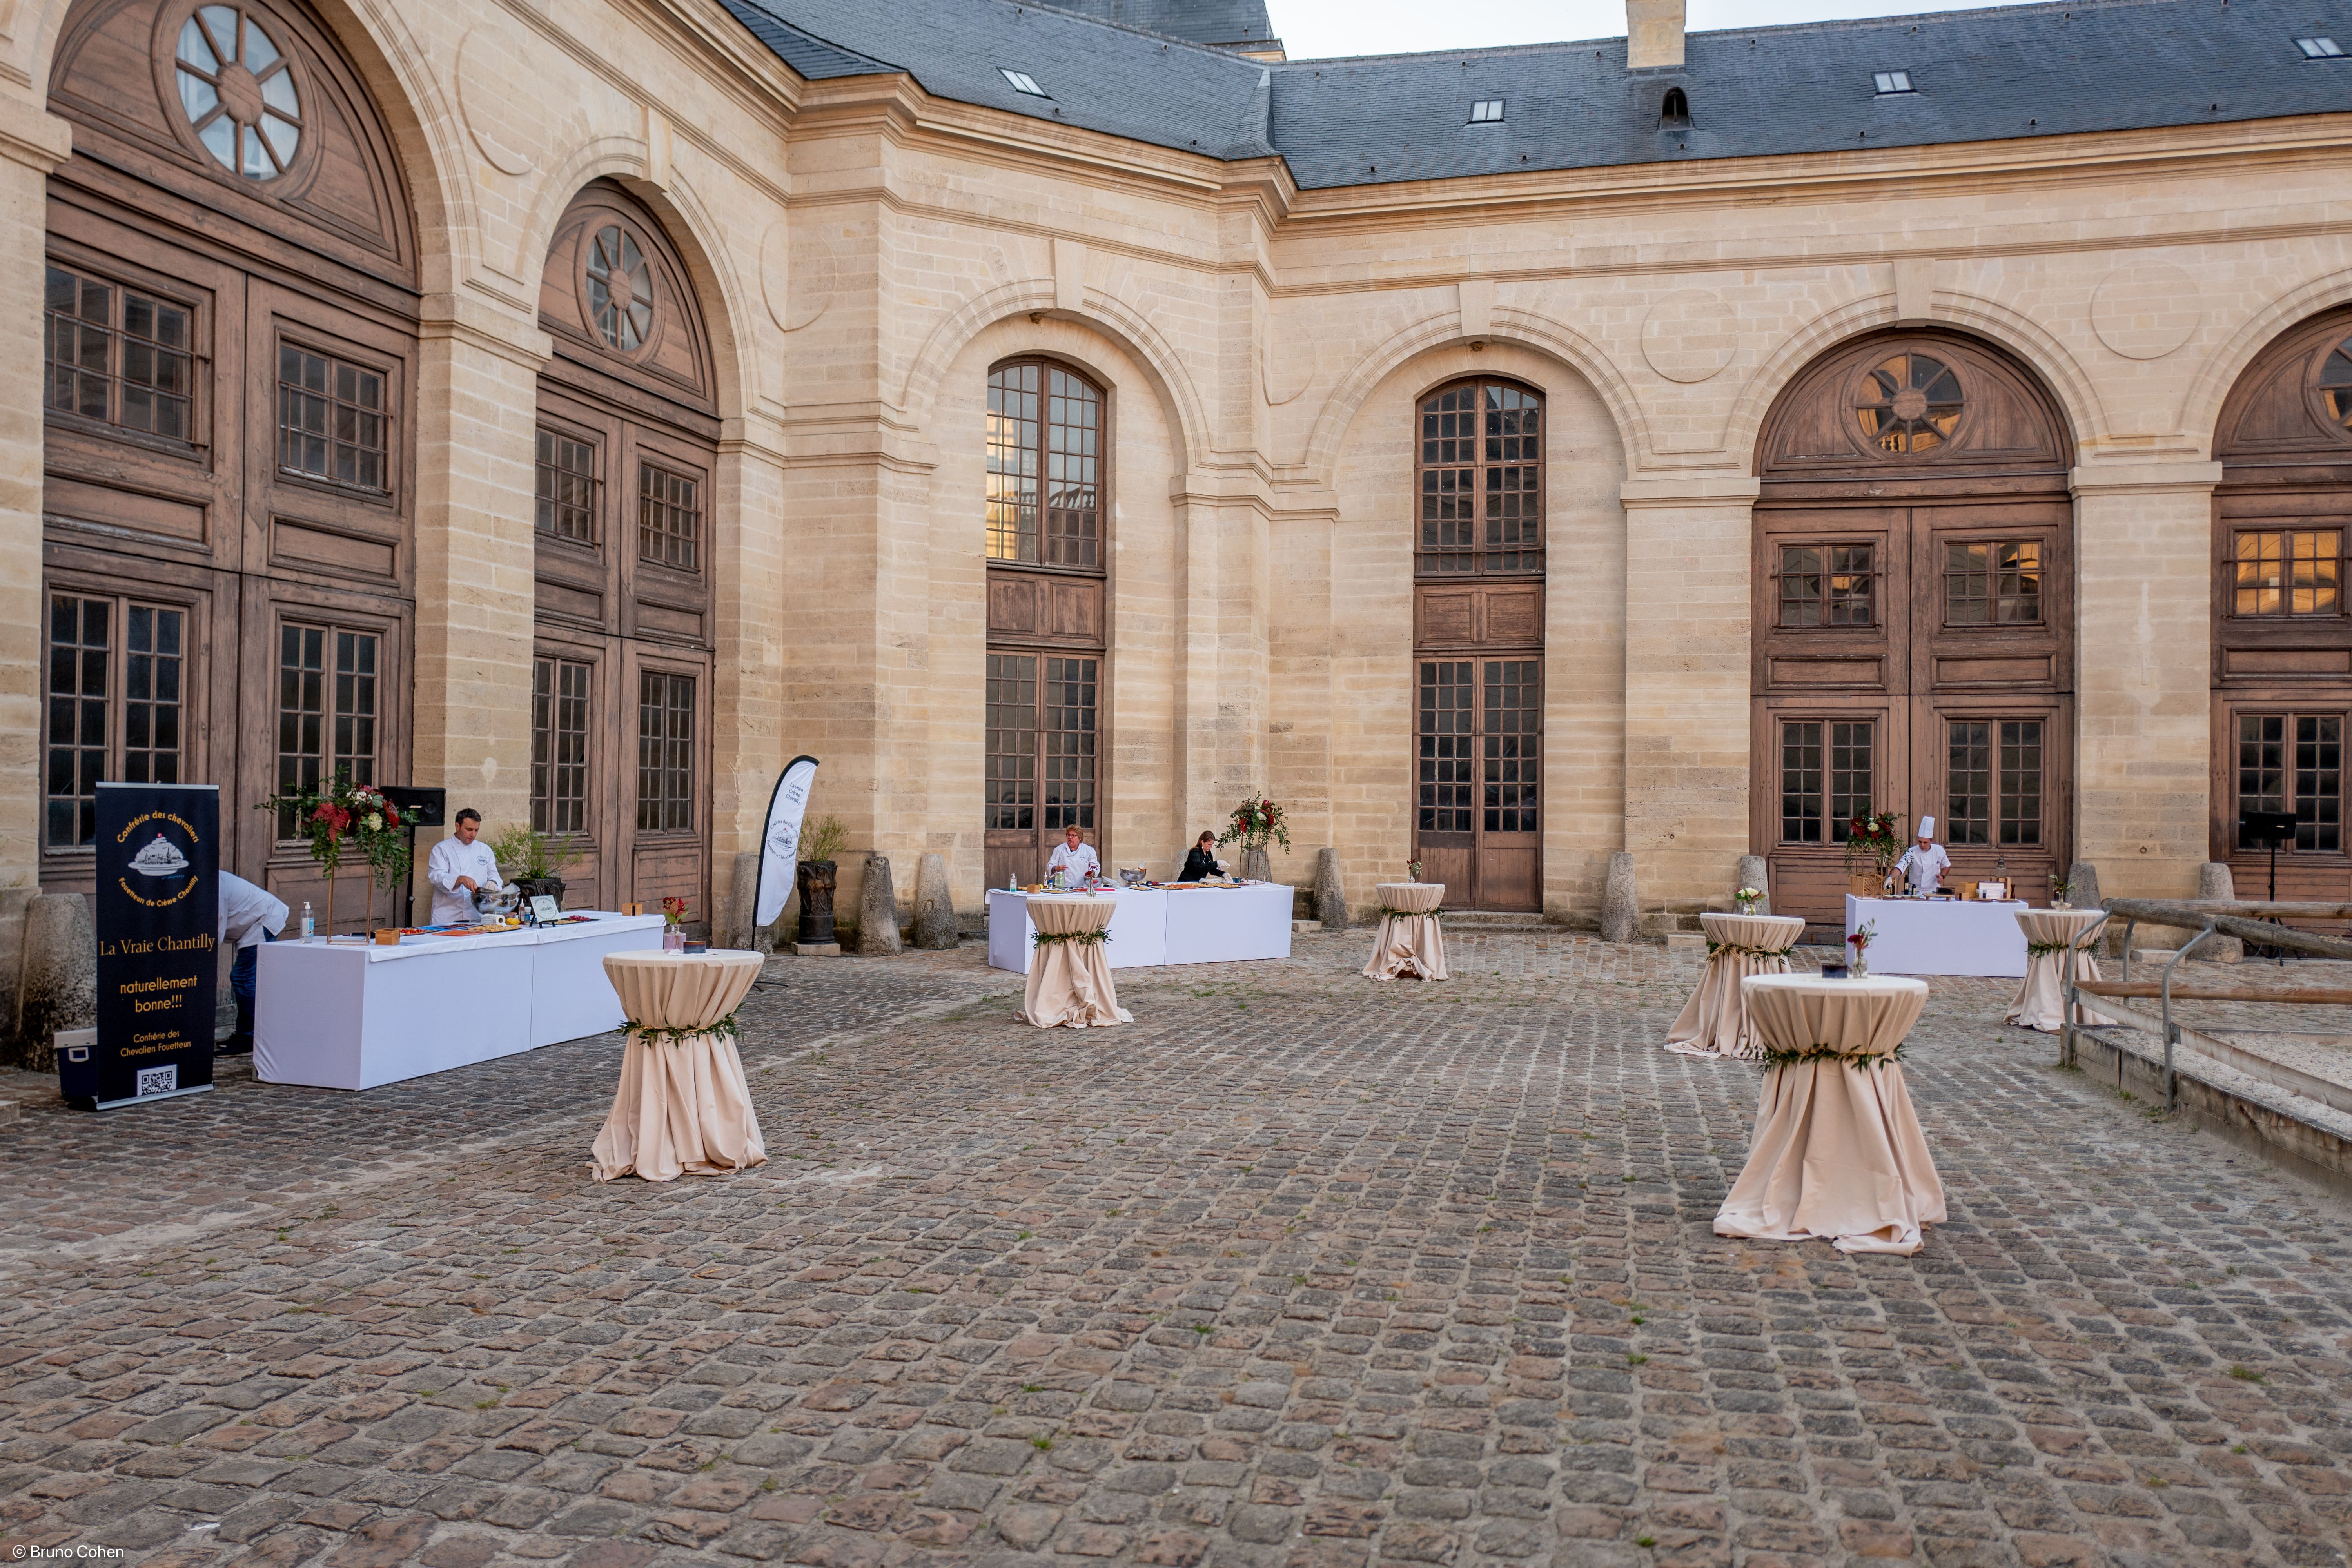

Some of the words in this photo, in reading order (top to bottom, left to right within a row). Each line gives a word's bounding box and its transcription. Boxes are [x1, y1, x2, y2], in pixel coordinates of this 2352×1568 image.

[789, 788, 800, 797] Crème
[117, 814, 150, 843] Confrérie
[152, 810, 165, 819] des
[167, 813, 200, 843] chevaliers
[119, 877, 145, 904] Fouetteurs
[156, 897, 177, 907] Crème
[178, 875, 198, 899] Chantilly
[100, 941, 116, 956] La
[121, 939, 153, 954] Vraie
[158, 933, 215, 952] Chantilly
[120, 975, 197, 994] naturellement
[135, 995, 182, 1013] bonne!!!
[134, 1032, 165, 1043] Confrérie
[167, 1029, 179, 1038] des
[120, 1045, 156, 1057] Chevaliers
[158, 1041, 191, 1051] Fouetteurs
